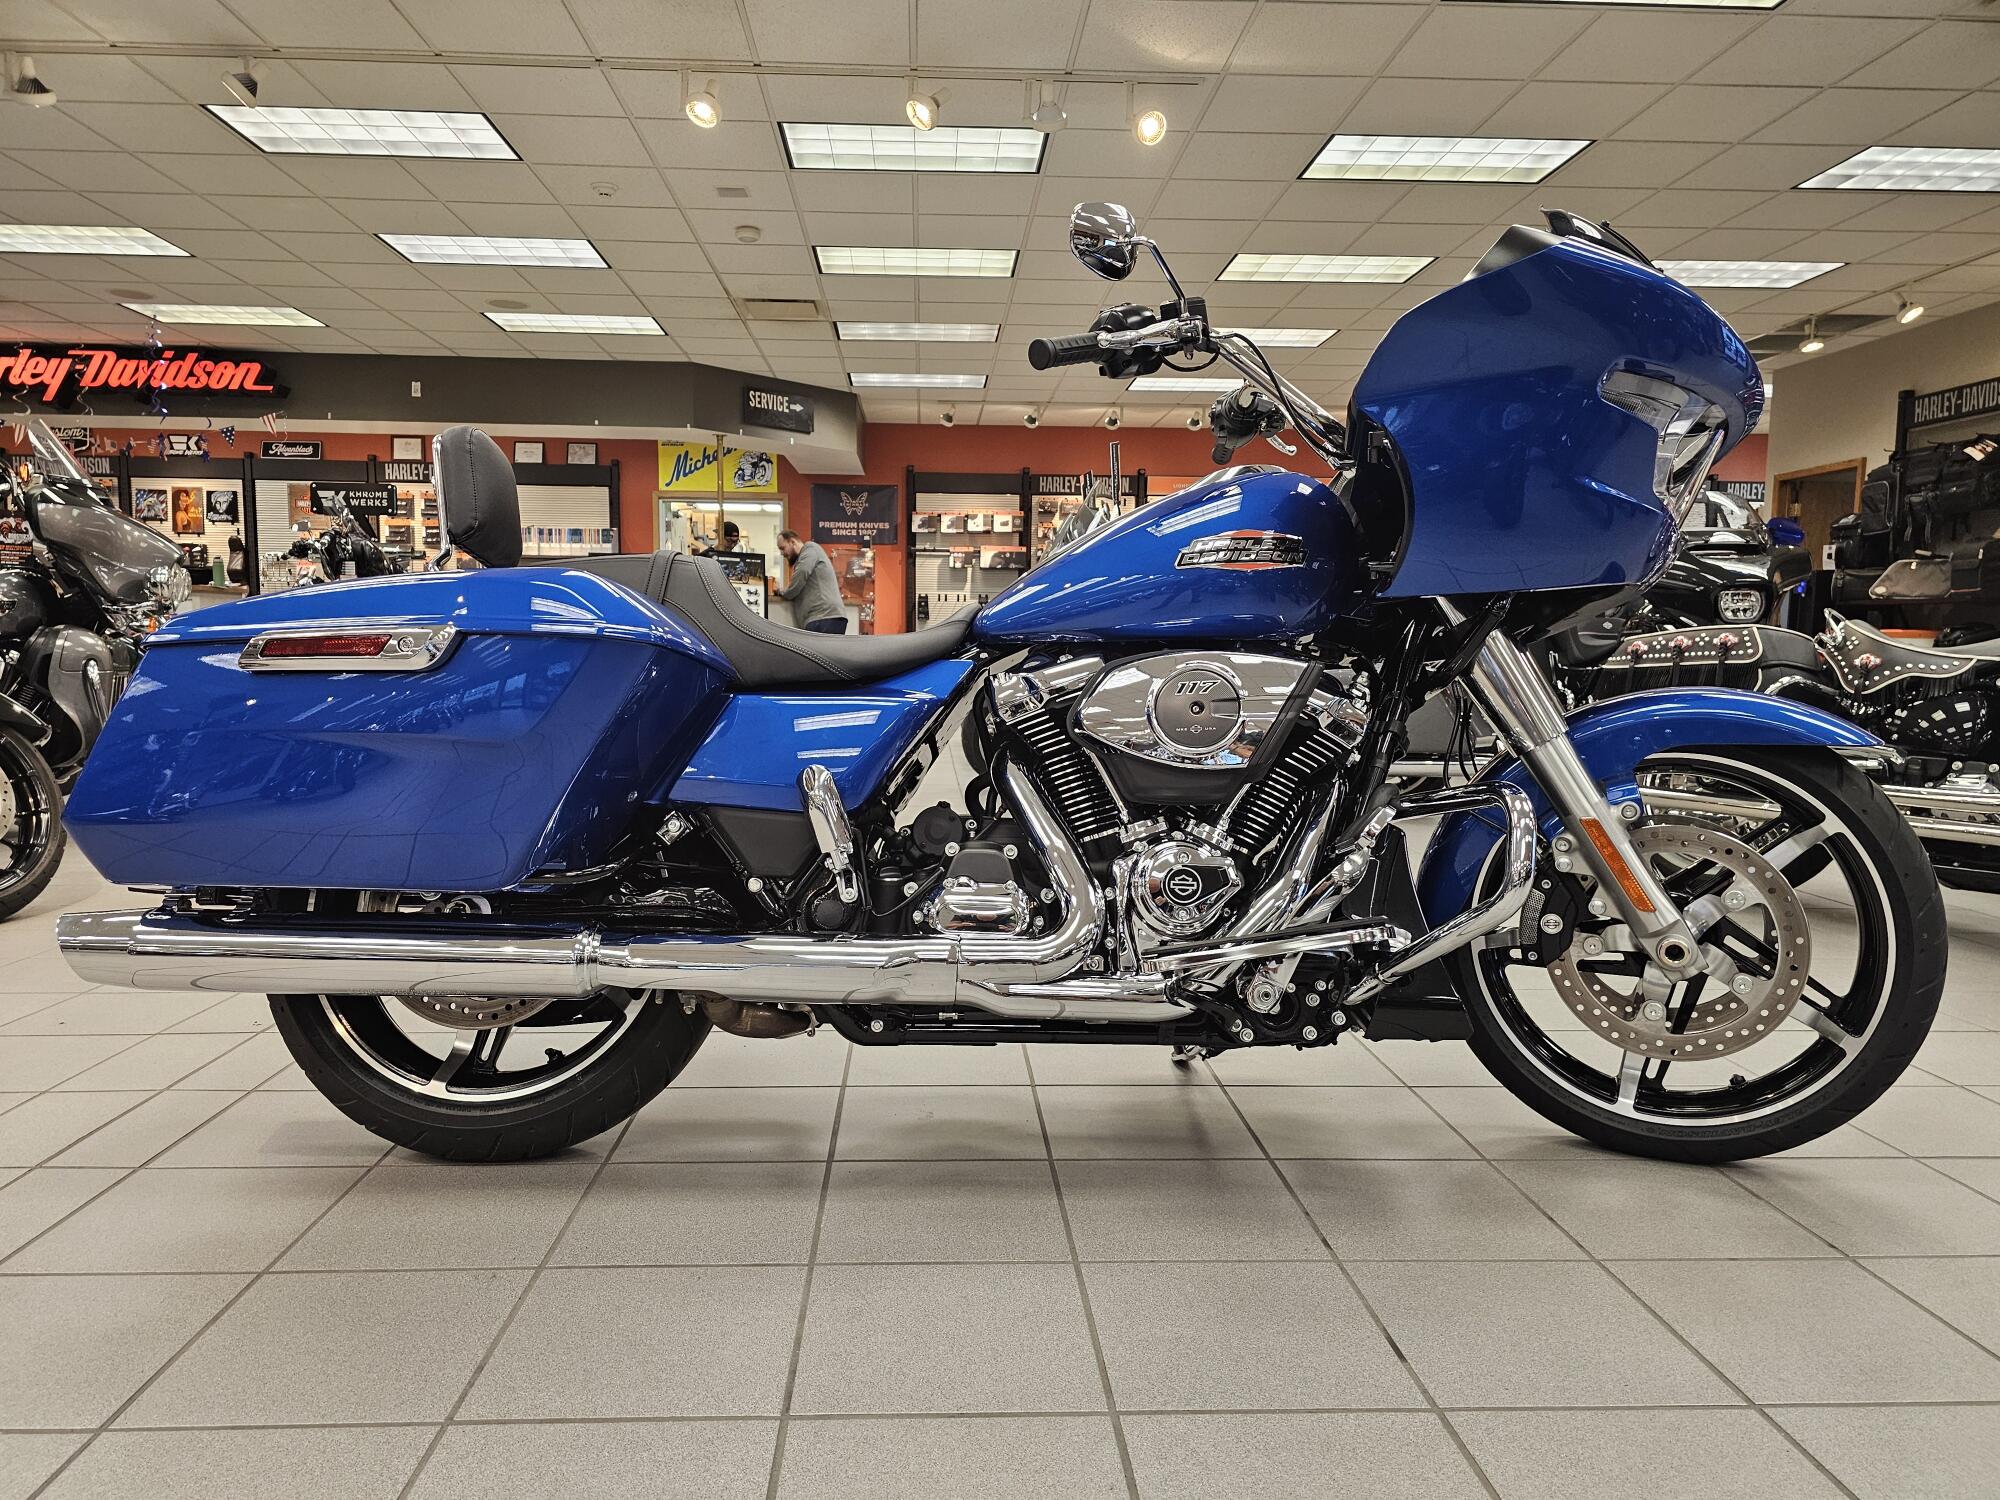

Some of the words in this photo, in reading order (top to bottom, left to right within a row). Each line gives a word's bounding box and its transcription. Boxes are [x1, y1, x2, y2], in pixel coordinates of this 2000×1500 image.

[749, 390, 789, 413] SERVICE
[349, 498, 388, 506] WERKS
[818, 521, 857, 529] PREMIUM
[1174, 680, 1221, 696] 117
